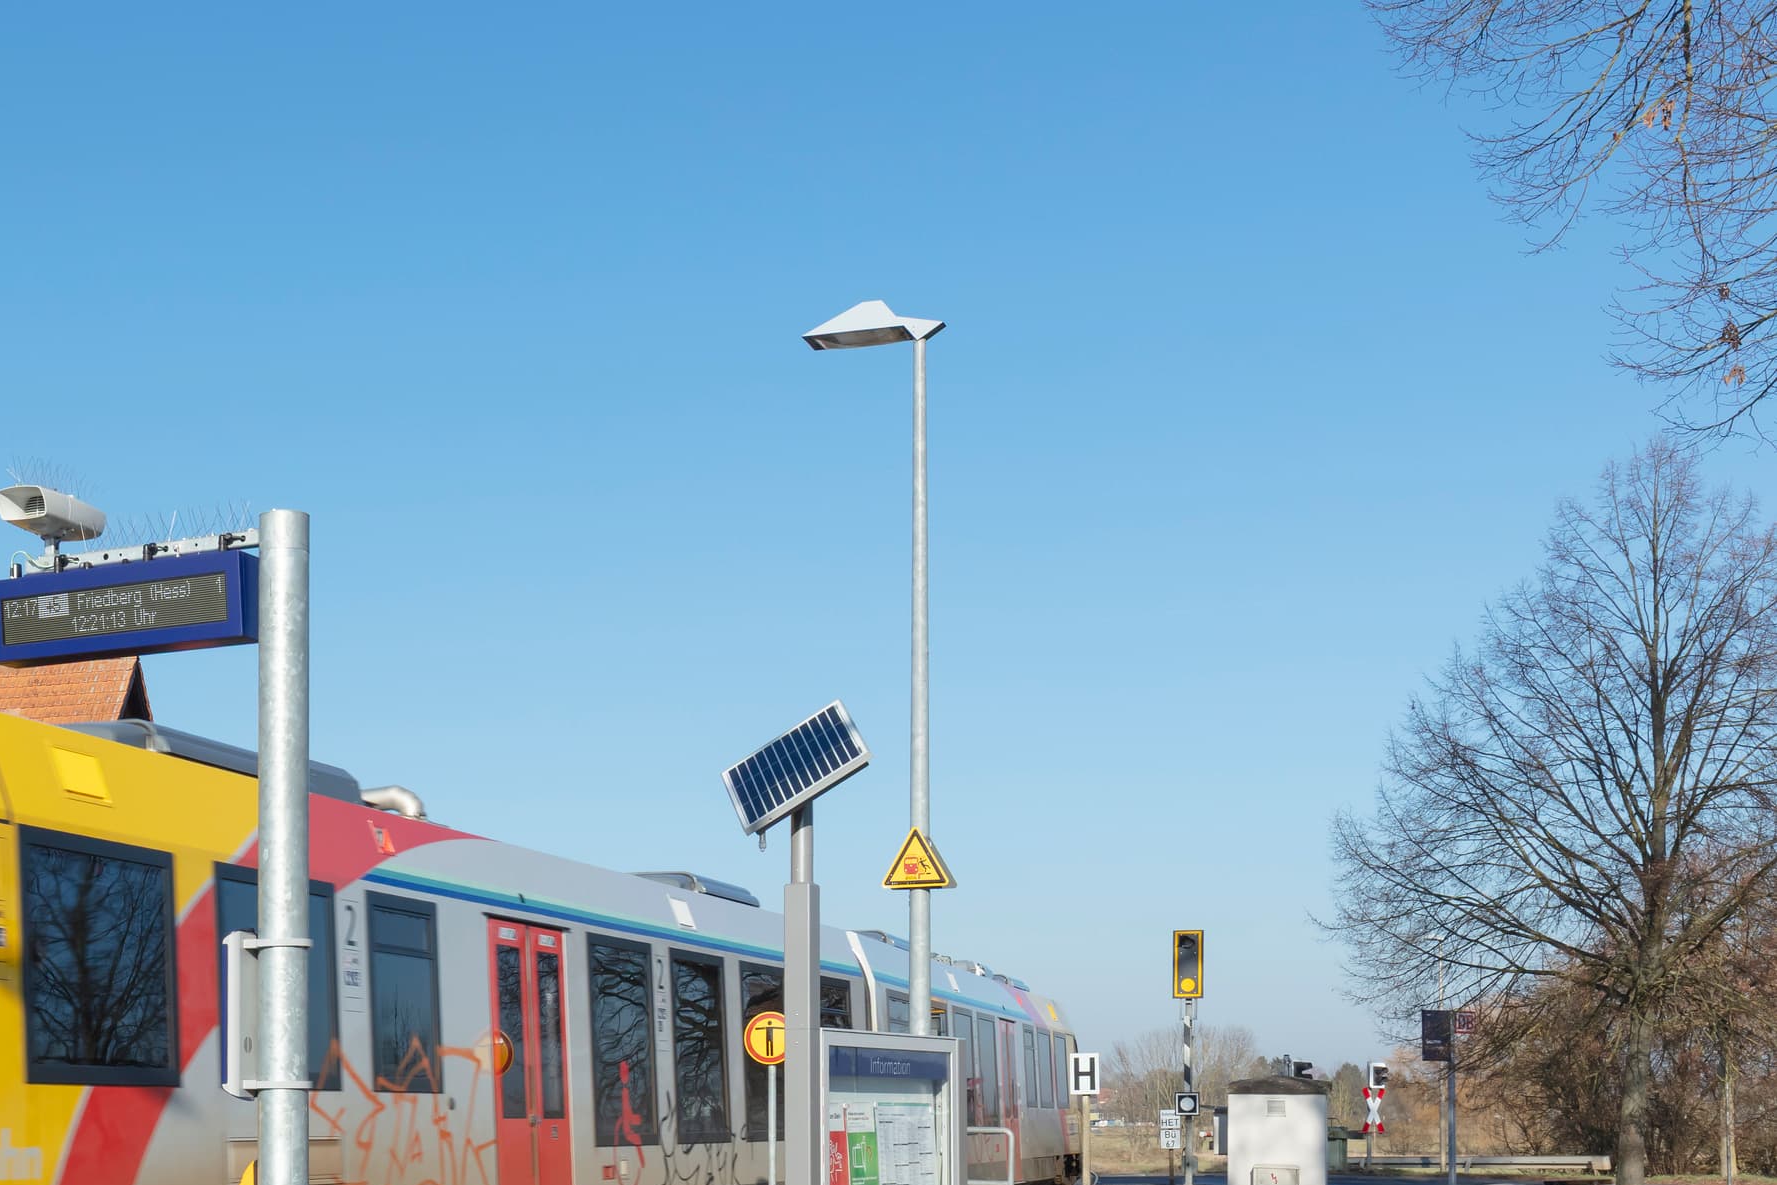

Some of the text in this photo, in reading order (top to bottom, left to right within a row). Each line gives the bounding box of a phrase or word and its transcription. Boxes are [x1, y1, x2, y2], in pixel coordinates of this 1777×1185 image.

[4, 600, 38, 619] 12:17
[77, 590, 143, 609] Friedberg
[150, 580, 191, 601] (Hess)
[215, 576, 223, 593] 1
[72, 608, 157, 633] 12:21:13 Uhr
[345, 905, 357, 947] 2
[870, 1056, 911, 1075] Information
[1073, 1056, 1096, 1091] H
[1161, 1118, 1179, 1127] HET
